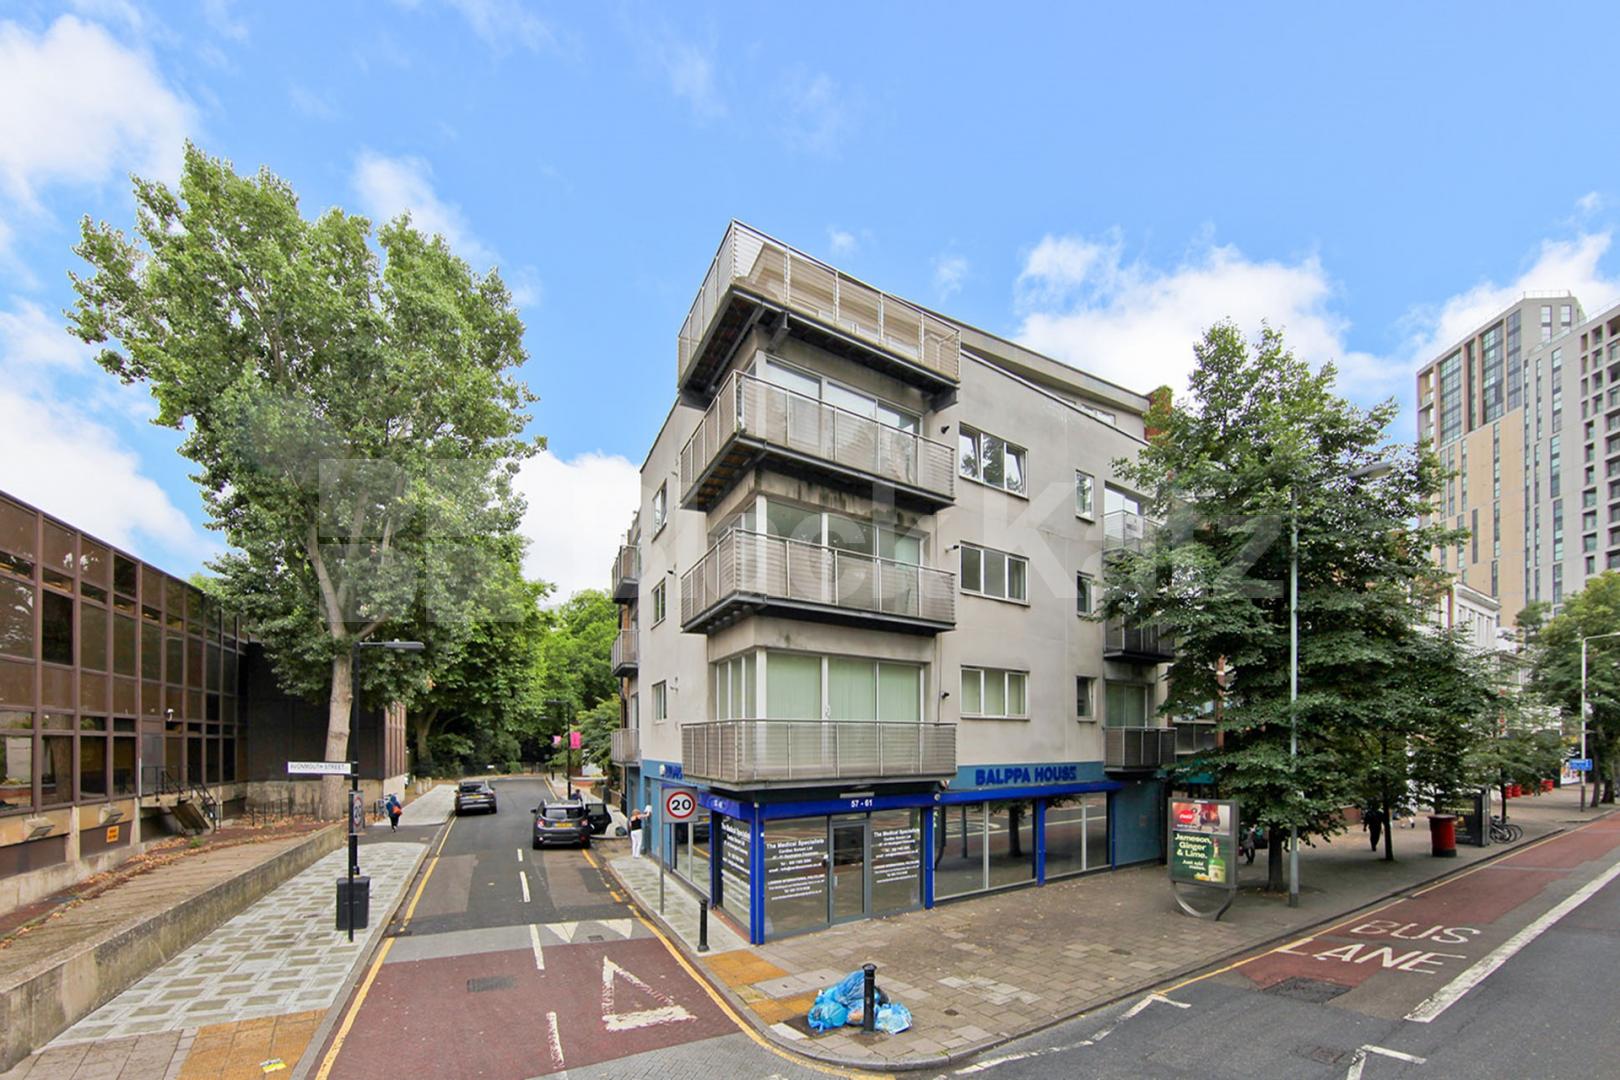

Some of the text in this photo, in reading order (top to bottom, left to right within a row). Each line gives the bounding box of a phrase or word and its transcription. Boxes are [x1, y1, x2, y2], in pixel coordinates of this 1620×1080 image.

[975, 765, 1077, 786] BALPPA HOUSE
[671, 799, 692, 811] 20
[1175, 833, 1212, 845] Jameson,
[1179, 842, 1206, 851] Ginger
[1176, 849, 1208, 859] & Lime.
[1350, 920, 1481, 943] BUS
[1277, 937, 1467, 974] LANE
